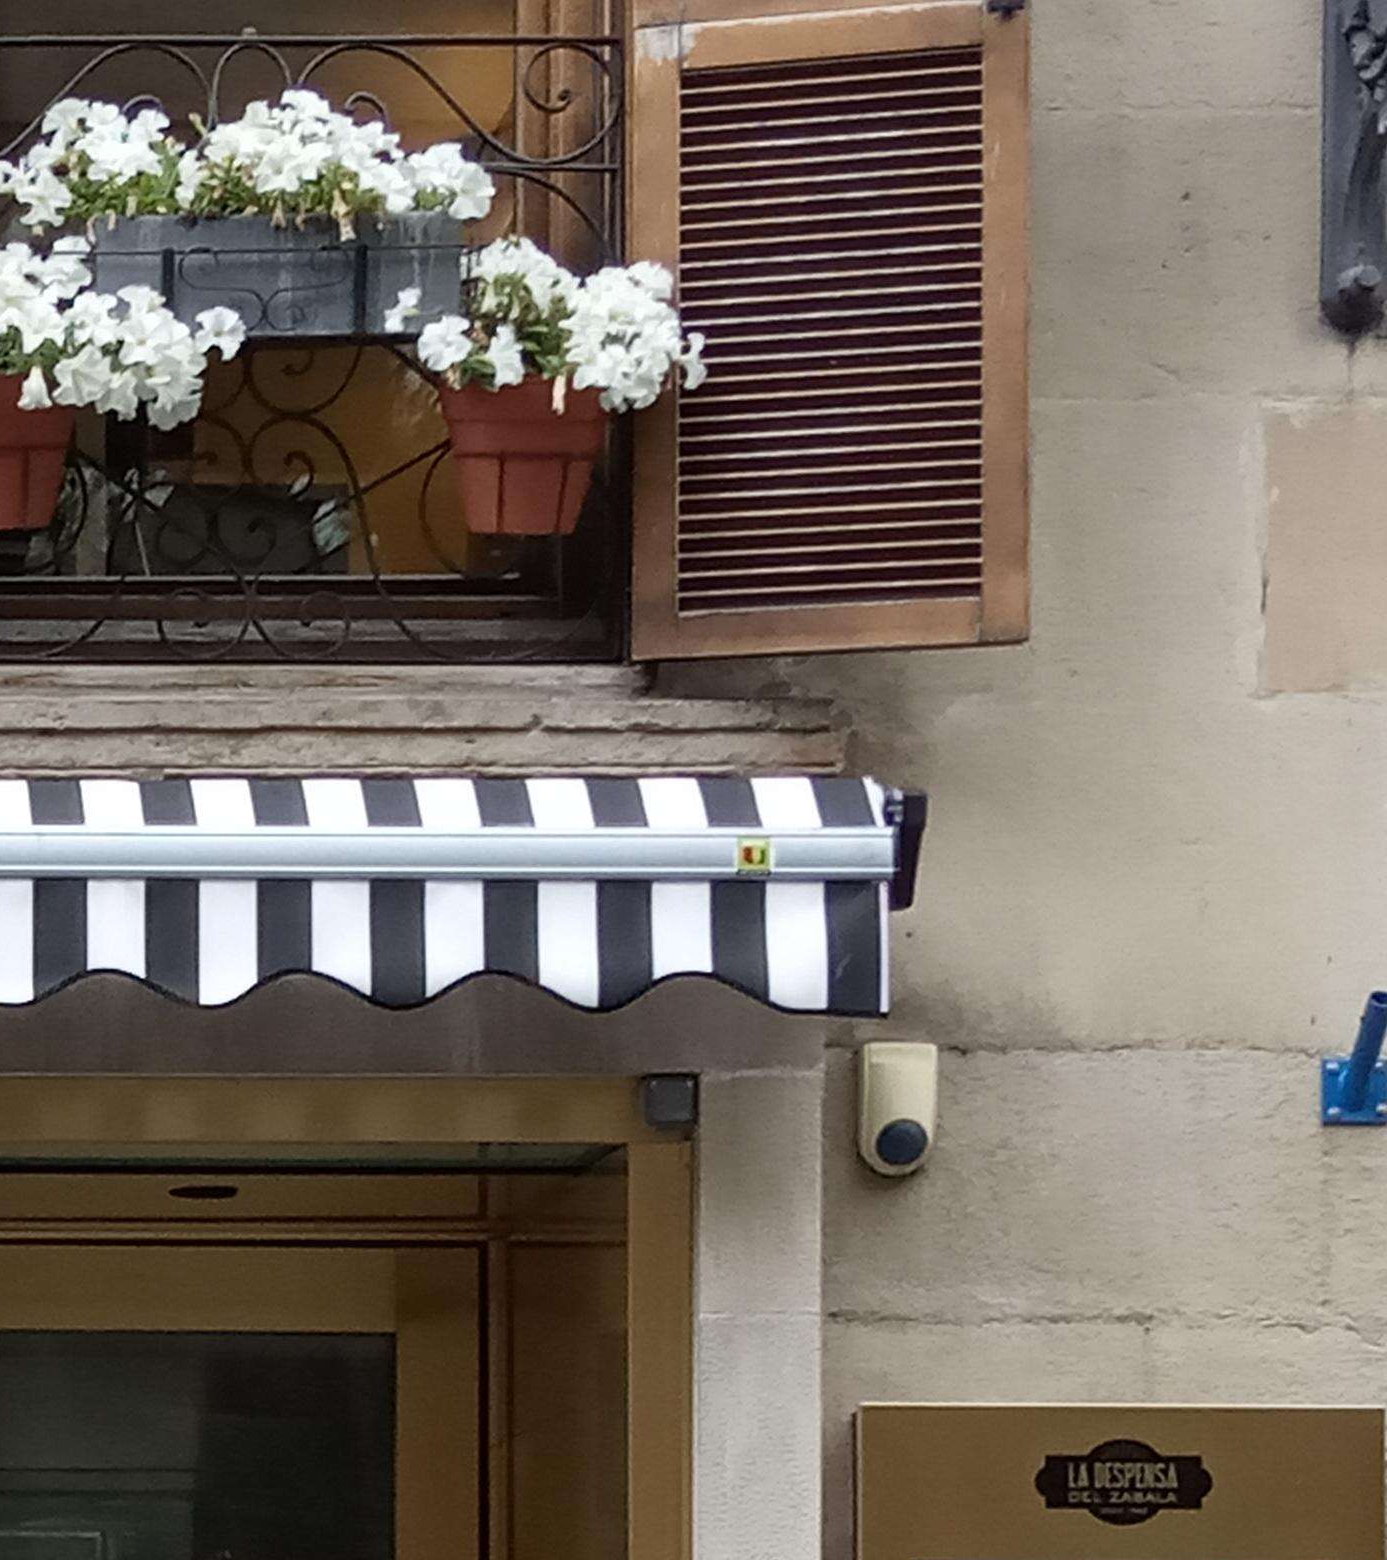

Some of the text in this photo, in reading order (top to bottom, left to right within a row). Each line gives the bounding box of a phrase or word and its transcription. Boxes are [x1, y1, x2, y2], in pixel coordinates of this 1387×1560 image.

[1067, 1462, 1178, 1488] LA DESPENSA
[1109, 1491, 1177, 1504] ZABALA
